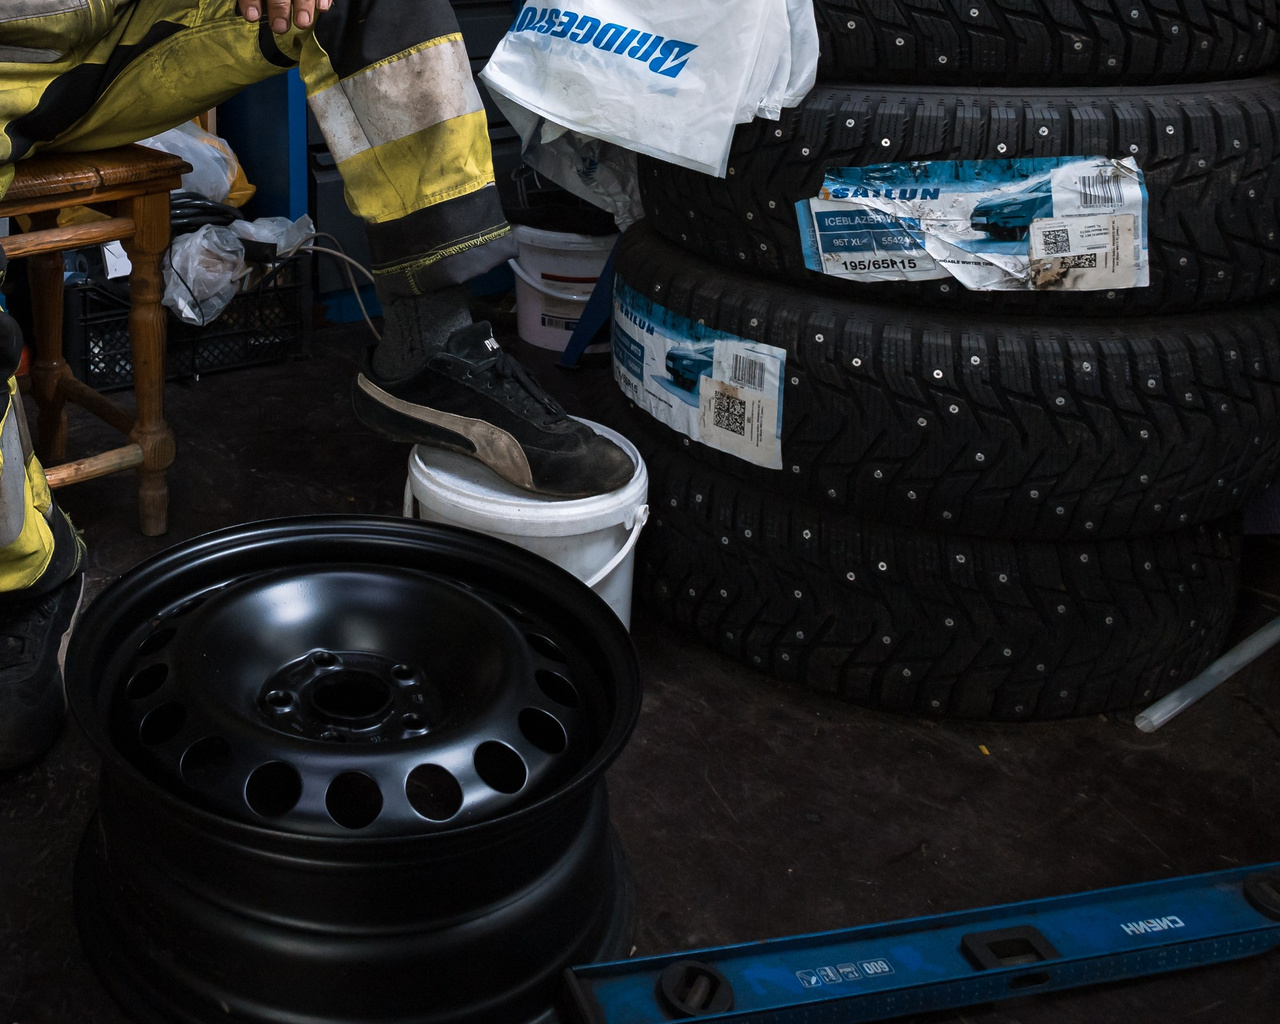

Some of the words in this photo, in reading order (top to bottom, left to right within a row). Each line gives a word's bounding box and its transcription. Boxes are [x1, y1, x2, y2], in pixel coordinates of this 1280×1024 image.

[832, 186, 941, 201] SAILUN
[832, 238, 848, 247] 95T
[851, 237, 862, 246] XL
[841, 258, 918, 272] 195/65R15
[1122, 914, 1186, 935] СИБИН
[863, 960, 890, 975] 600
